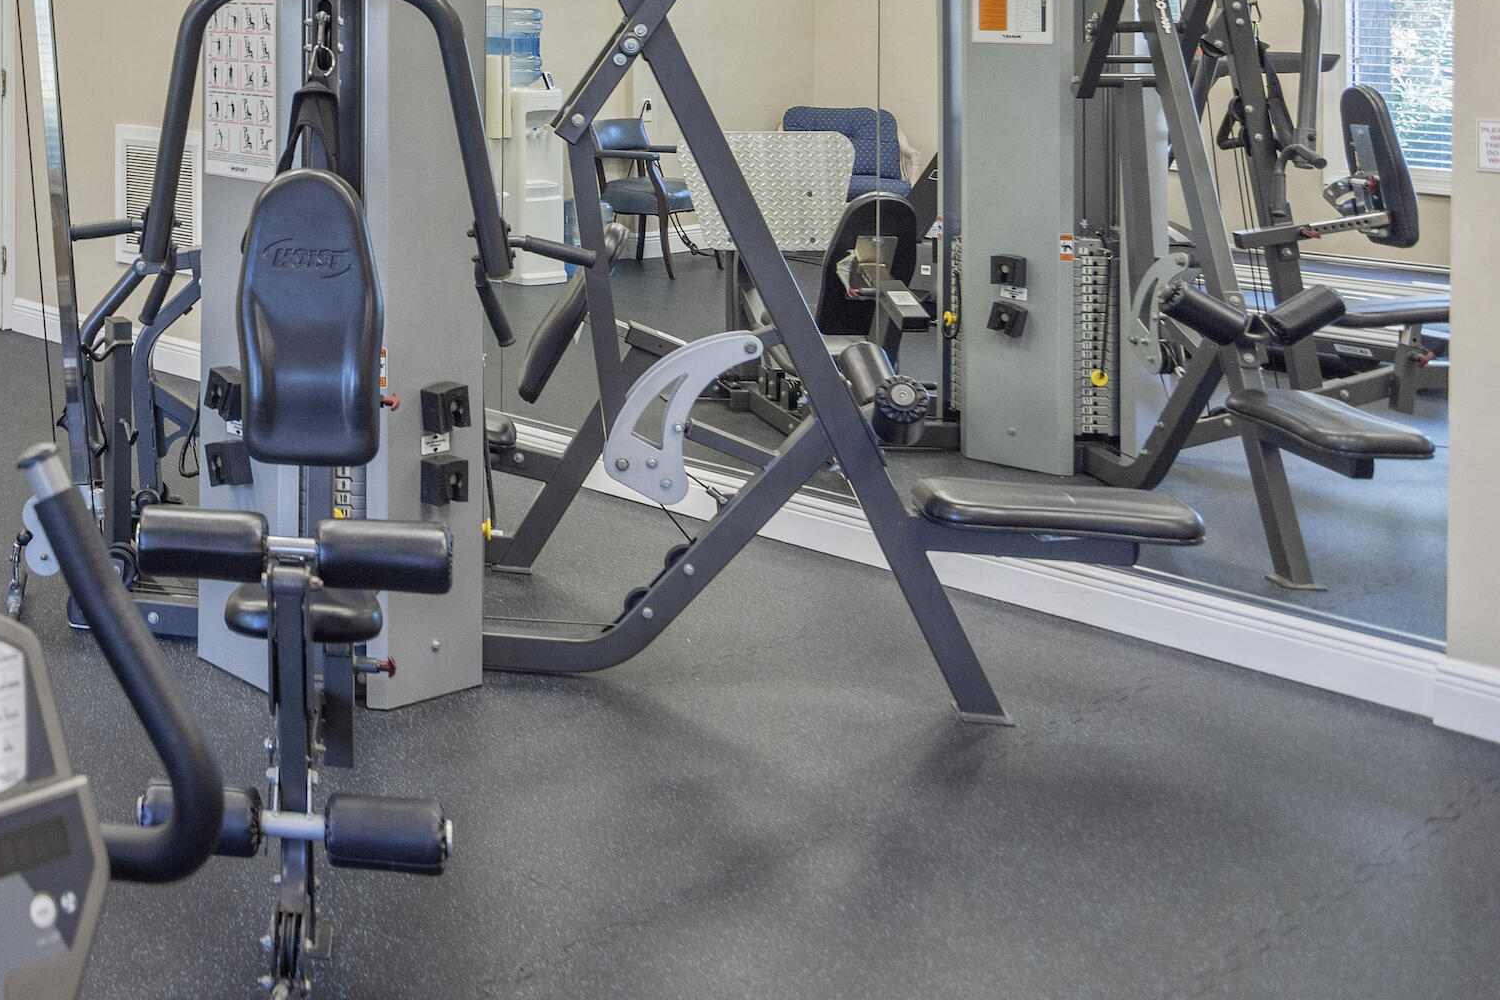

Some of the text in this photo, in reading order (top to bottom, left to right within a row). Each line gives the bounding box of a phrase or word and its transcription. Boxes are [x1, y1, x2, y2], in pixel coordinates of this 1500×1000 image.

[272, 247, 352, 269] HOIST
[341, 481, 346, 490] 9
[340, 494, 348, 503] 10
